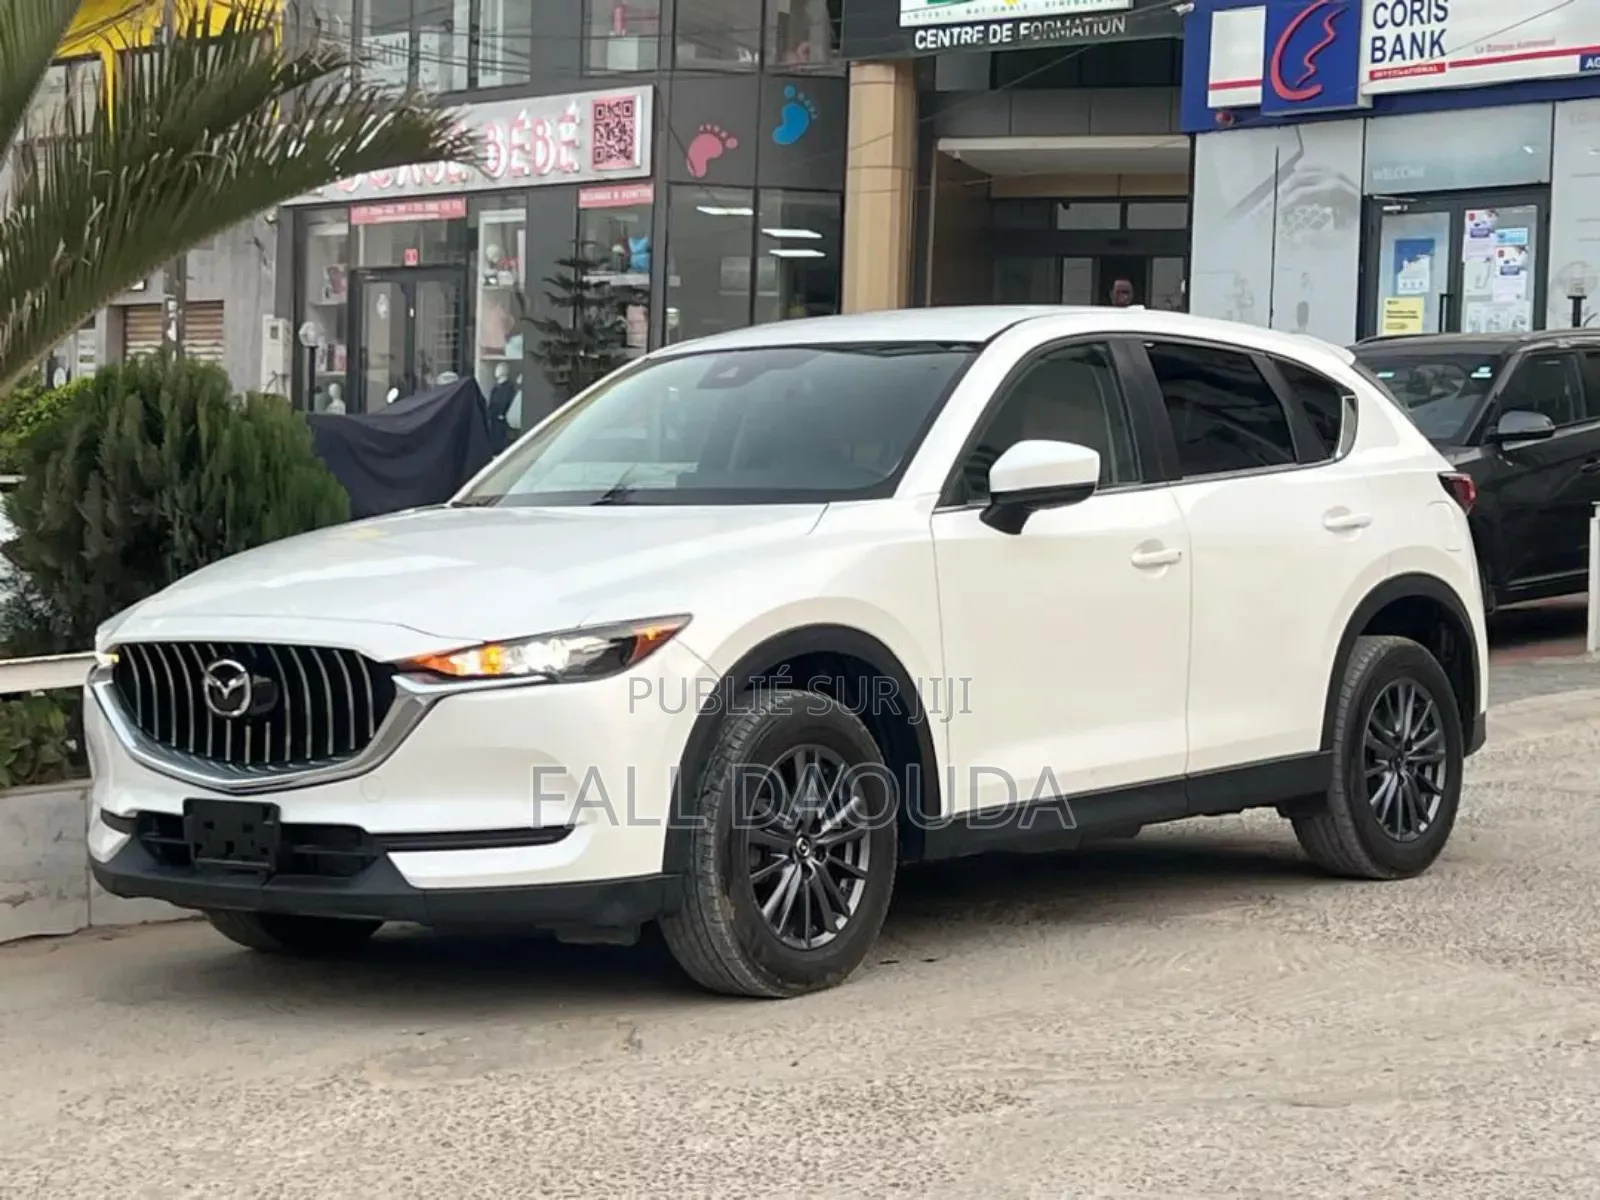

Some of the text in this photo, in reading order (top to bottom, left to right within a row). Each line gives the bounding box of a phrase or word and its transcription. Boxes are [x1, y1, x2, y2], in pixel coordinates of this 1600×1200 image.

[1373, 0, 1448, 29] CORIS
[914, 16, 1126, 50] CENTRE DE FORMATION
[1371, 29, 1446, 64] BANK
[1374, 65, 1439, 79] INTERNATIONAL
[485, 100, 581, 178] BÉBÉ
